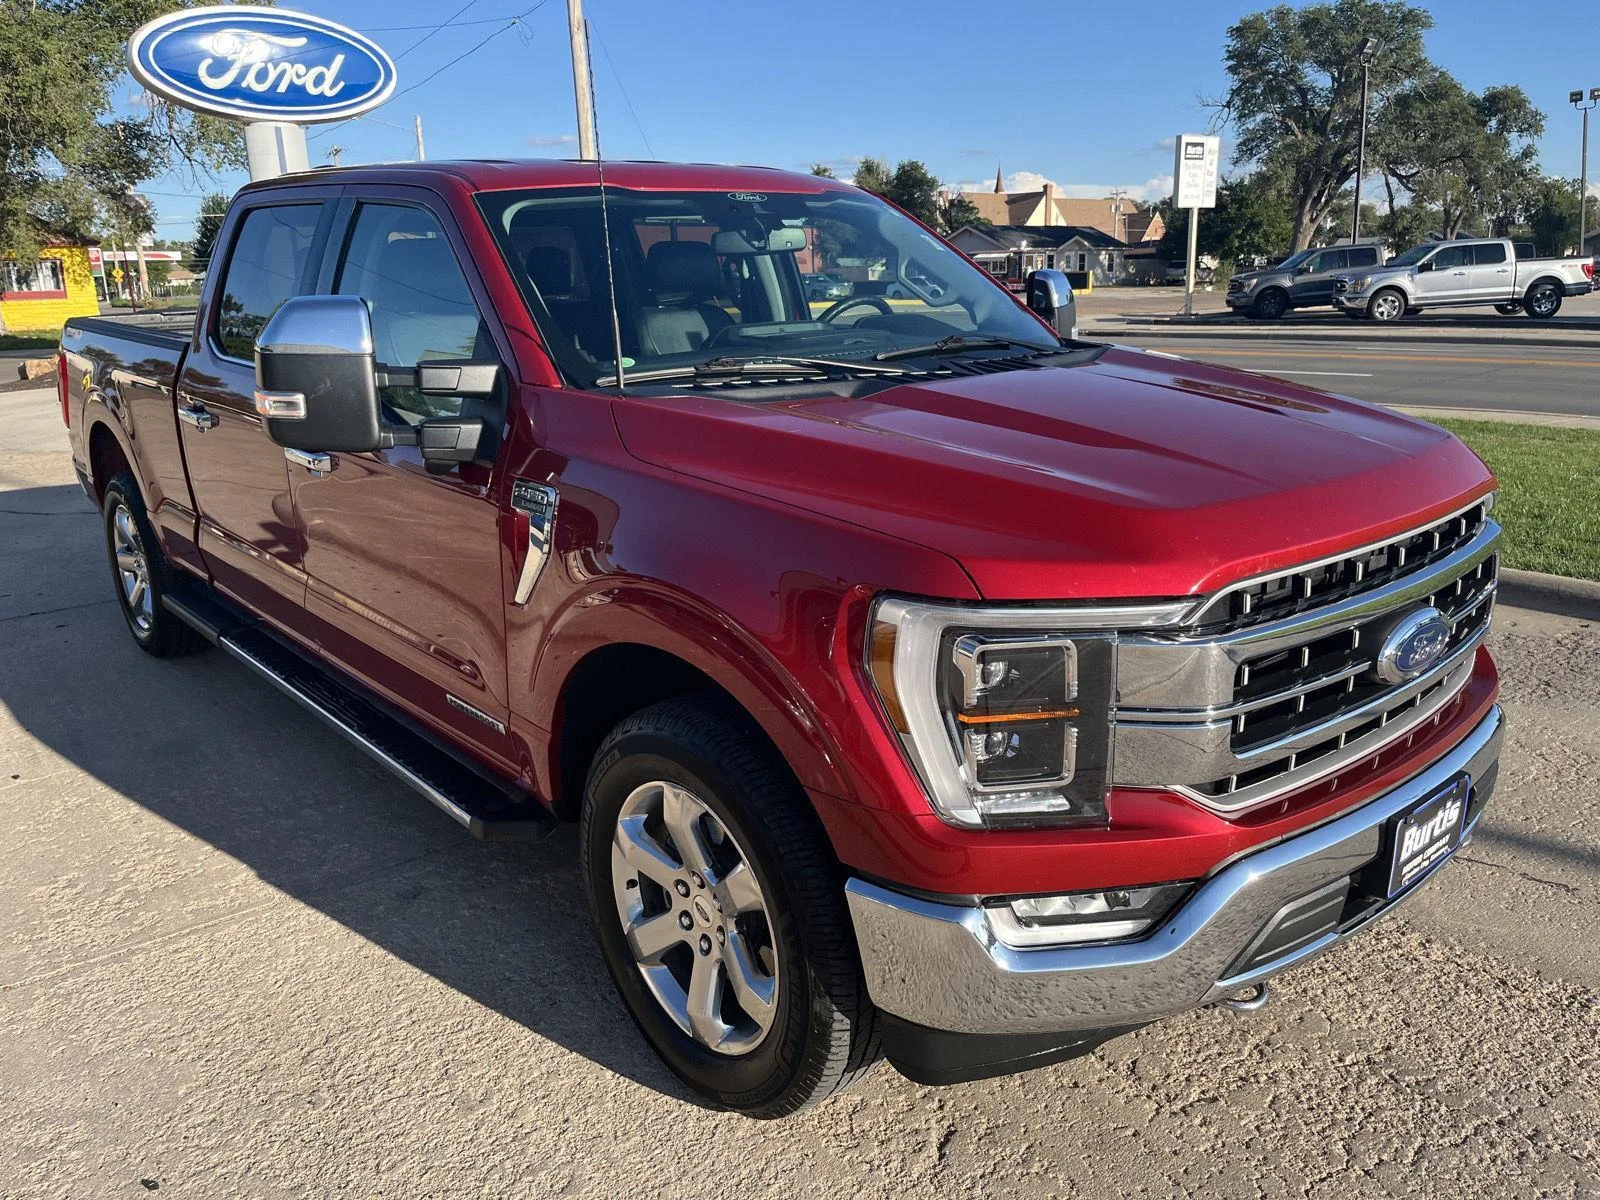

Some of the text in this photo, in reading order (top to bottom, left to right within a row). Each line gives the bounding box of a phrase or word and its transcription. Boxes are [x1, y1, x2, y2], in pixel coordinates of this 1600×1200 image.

[198, 28, 345, 97] Ford
[734, 192, 762, 201] Ford
[1399, 797, 1462, 863] Burtis
